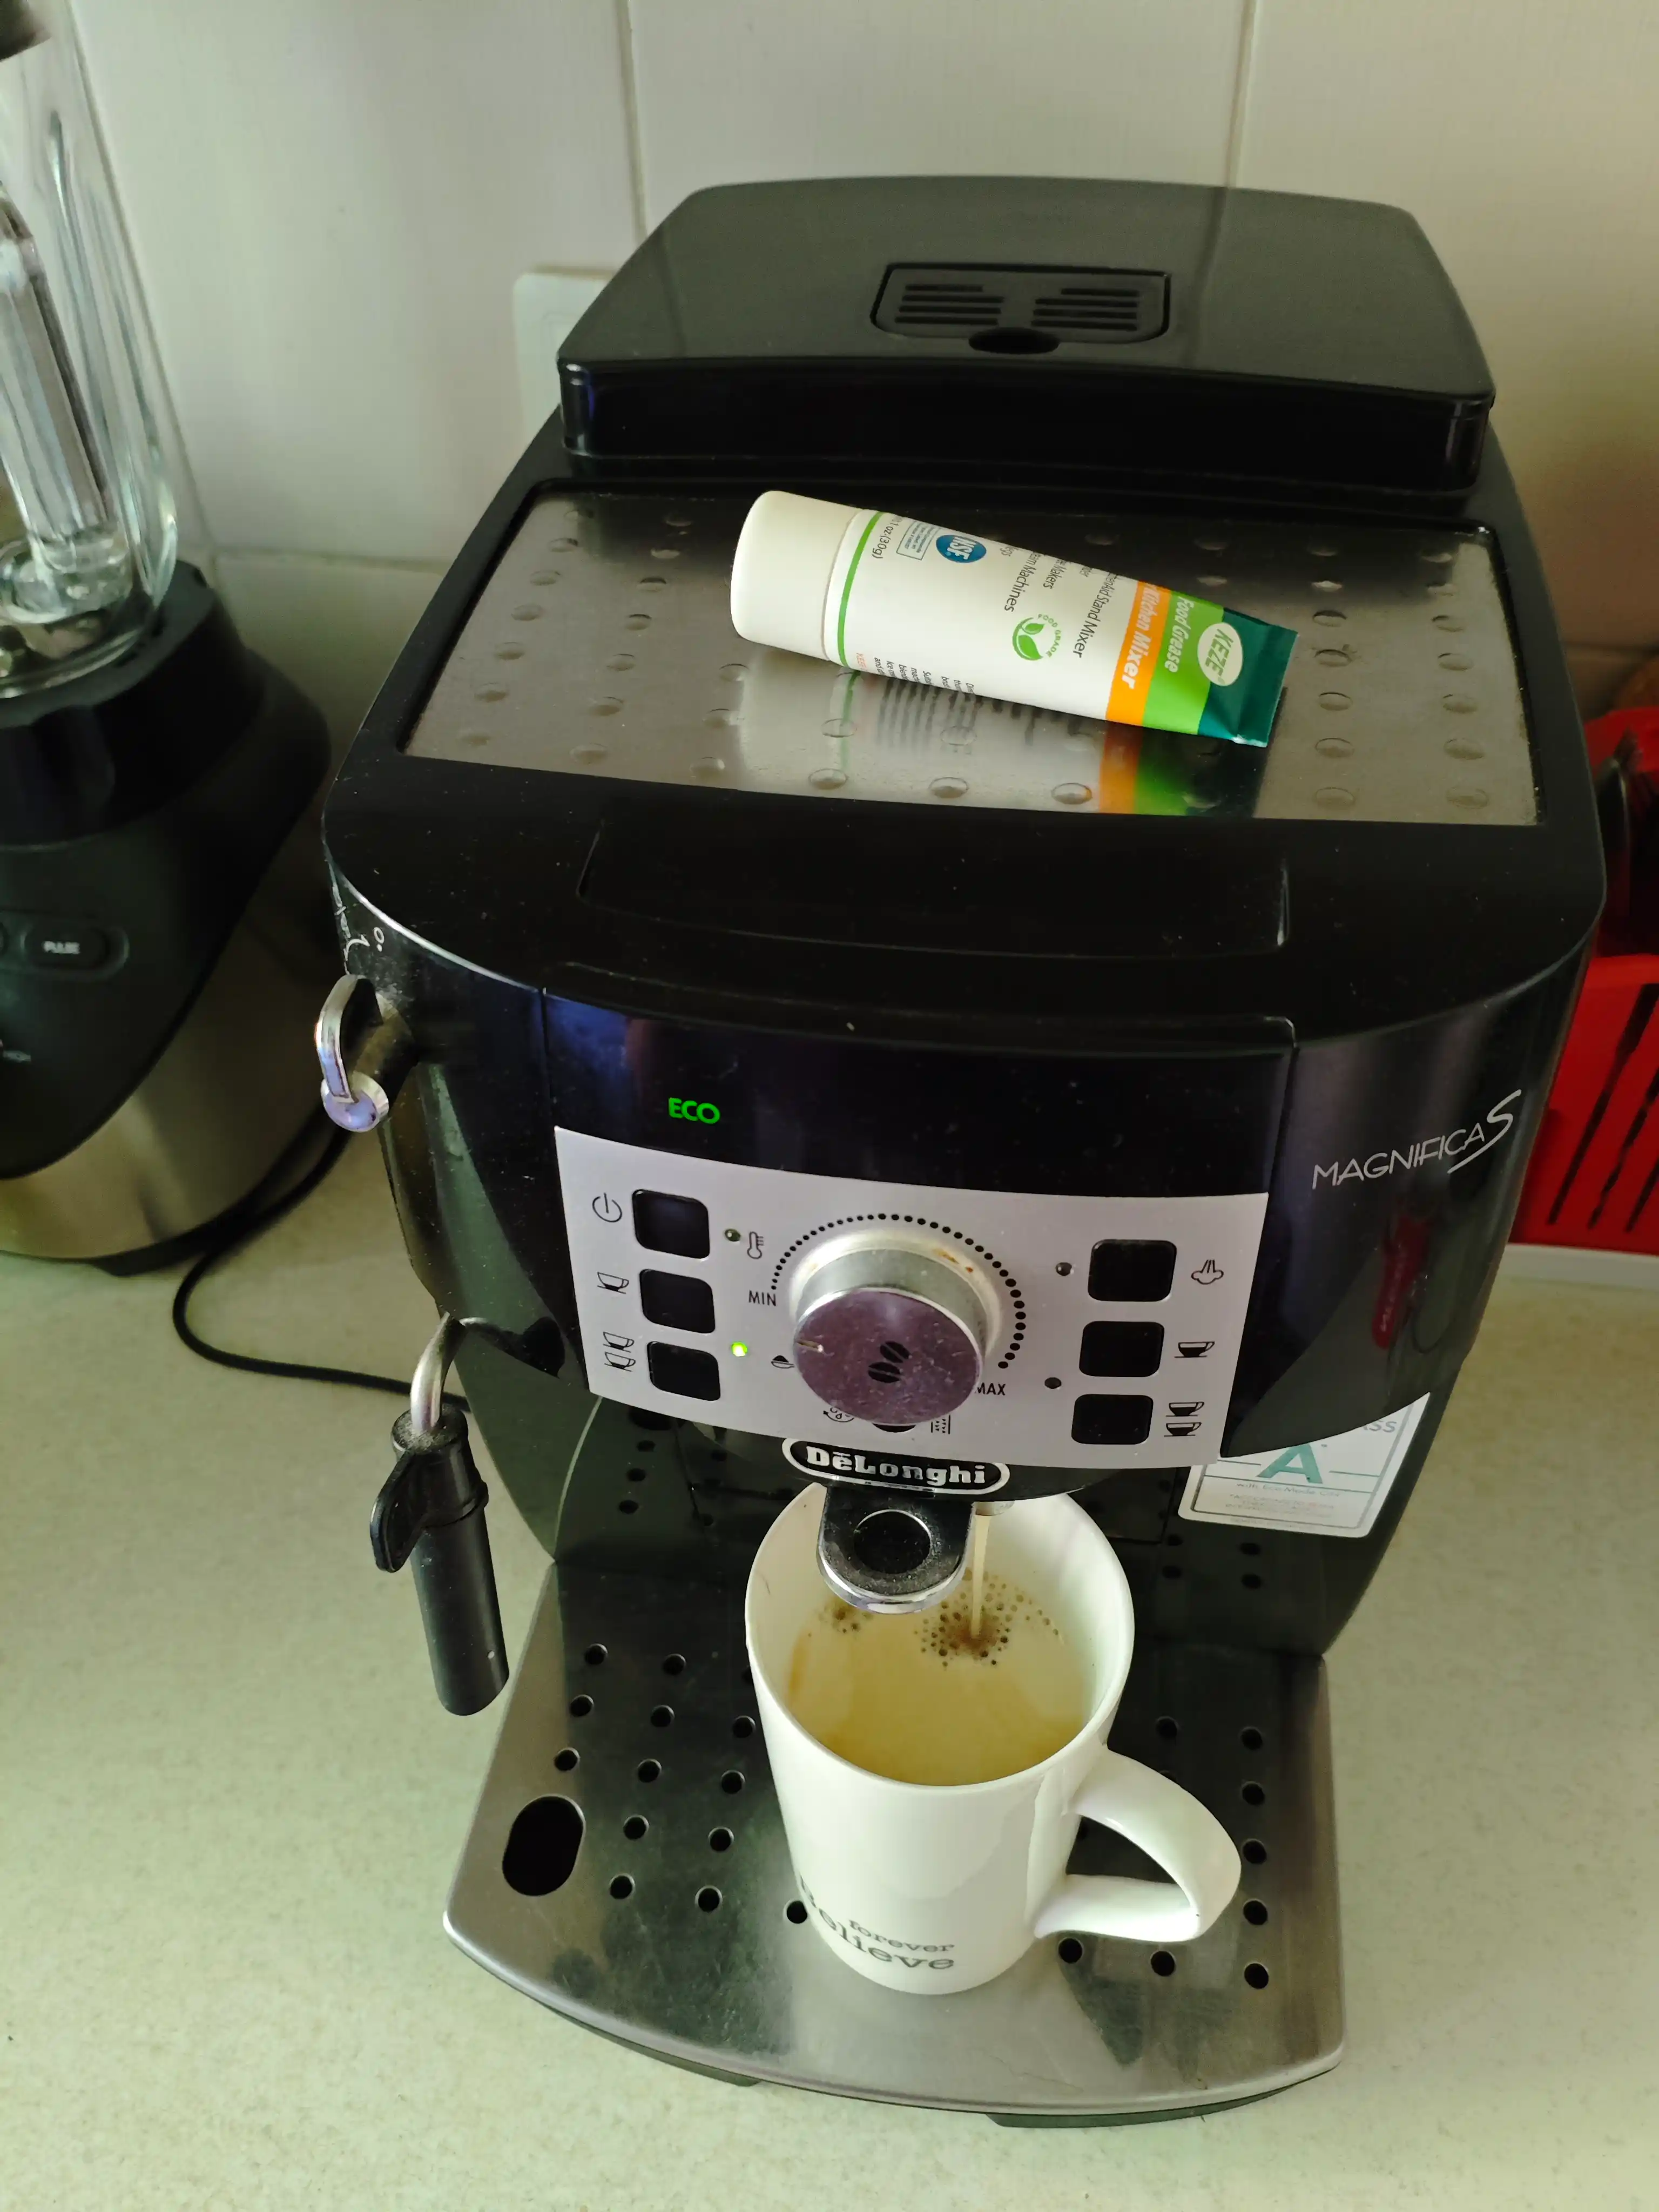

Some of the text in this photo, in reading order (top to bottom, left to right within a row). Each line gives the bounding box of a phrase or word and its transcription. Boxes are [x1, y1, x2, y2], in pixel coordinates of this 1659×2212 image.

[947, 536, 976, 560] NSF
[1004, 564, 1037, 612] Machines
[1042, 566, 1068, 590] Makers
[1087, 595, 1109, 622] Stand
[1136, 586, 1160, 631] Kitchen
[1038, 613, 1061, 658] FOOD GRADE
[1073, 620, 1098, 658] Mixer
[1164, 596, 1195, 673] Food Grease
[1205, 629, 1234, 677] KEZE
[1122, 630, 1152, 690] Mixer
[667, 1097, 720, 1124] ECO
[1312, 1122, 1485, 1190] MAGNIFICA
[748, 1290, 777, 1307] MIN
[975, 1382, 1006, 1396] MAX
[1256, 1442, 1324, 1485] A
[849, 1919, 955, 1953] forever
